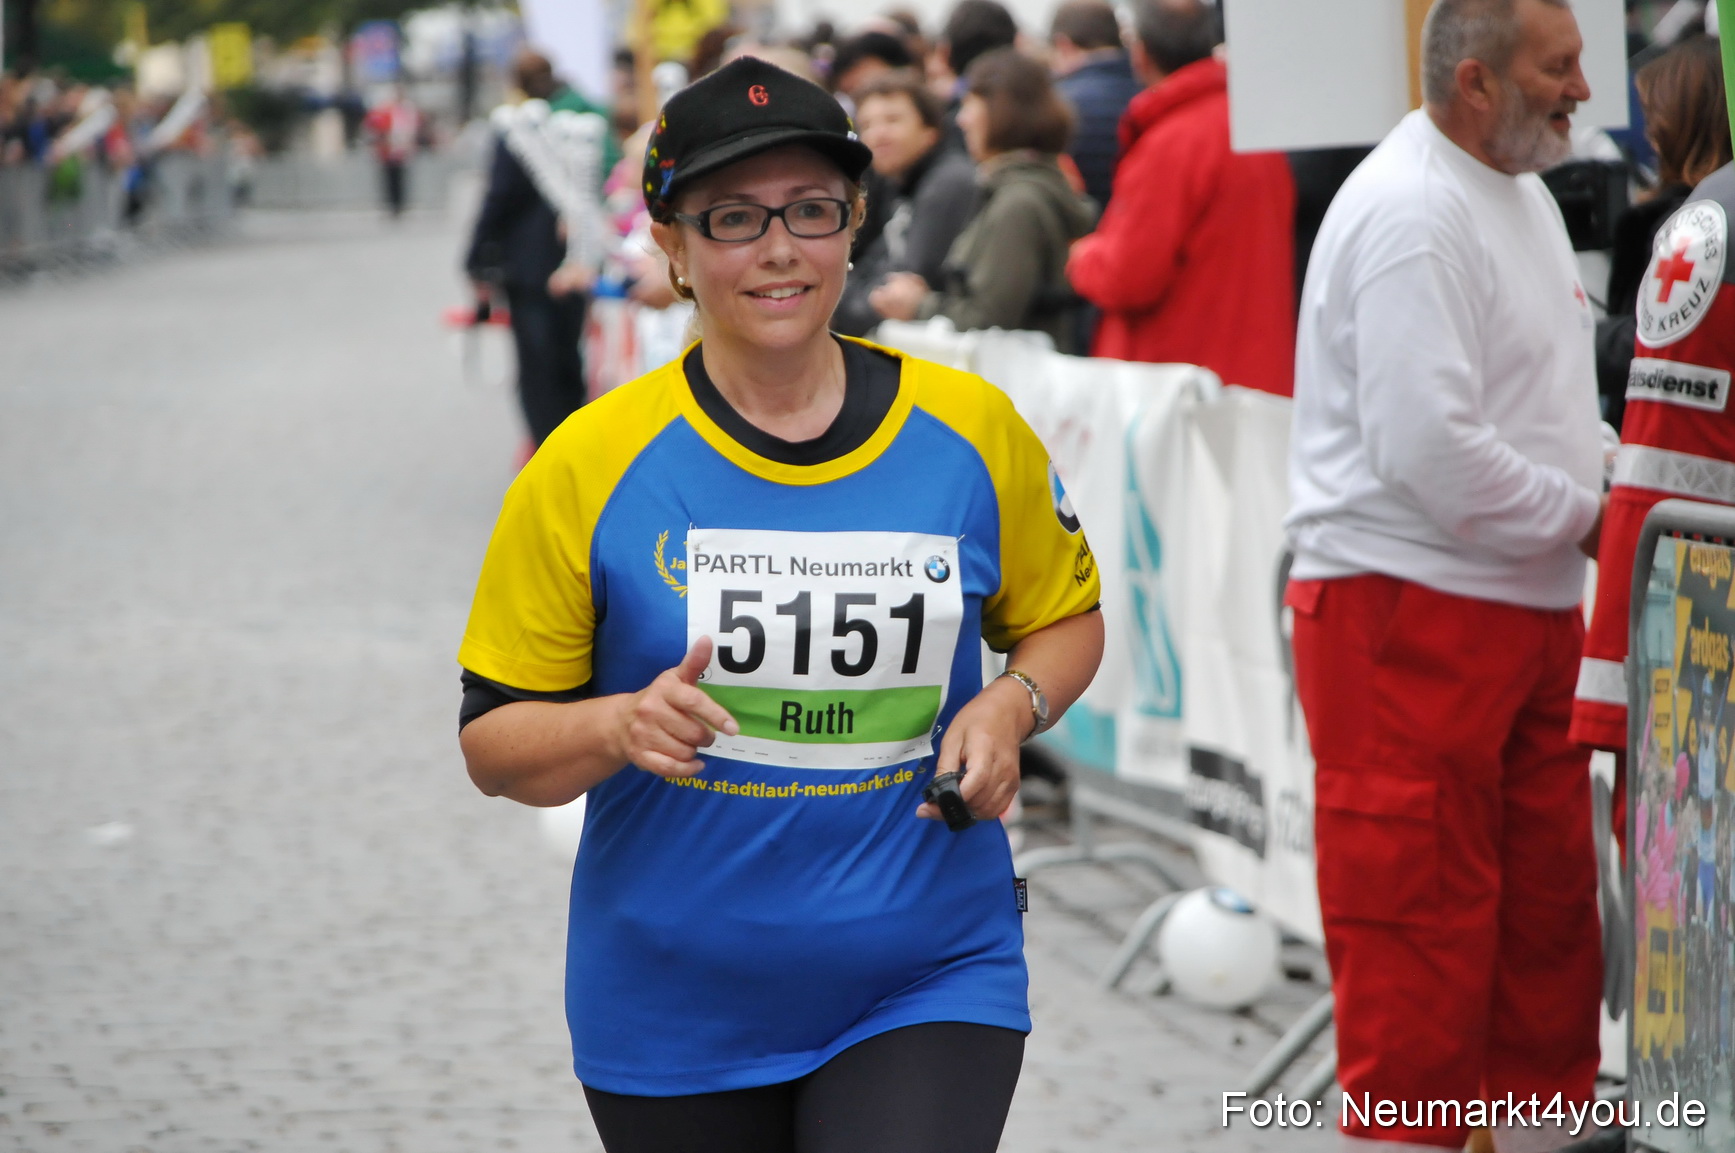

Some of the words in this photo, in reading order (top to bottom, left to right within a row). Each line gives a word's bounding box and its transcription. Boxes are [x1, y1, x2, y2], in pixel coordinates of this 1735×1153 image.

[1658, 278, 1710, 332] KREUZ
[693, 553, 782, 575] PARTL
[790, 556, 914, 578] Neumarkt
[717, 589, 925, 677] 5151
[779, 700, 854, 735] Ruth
